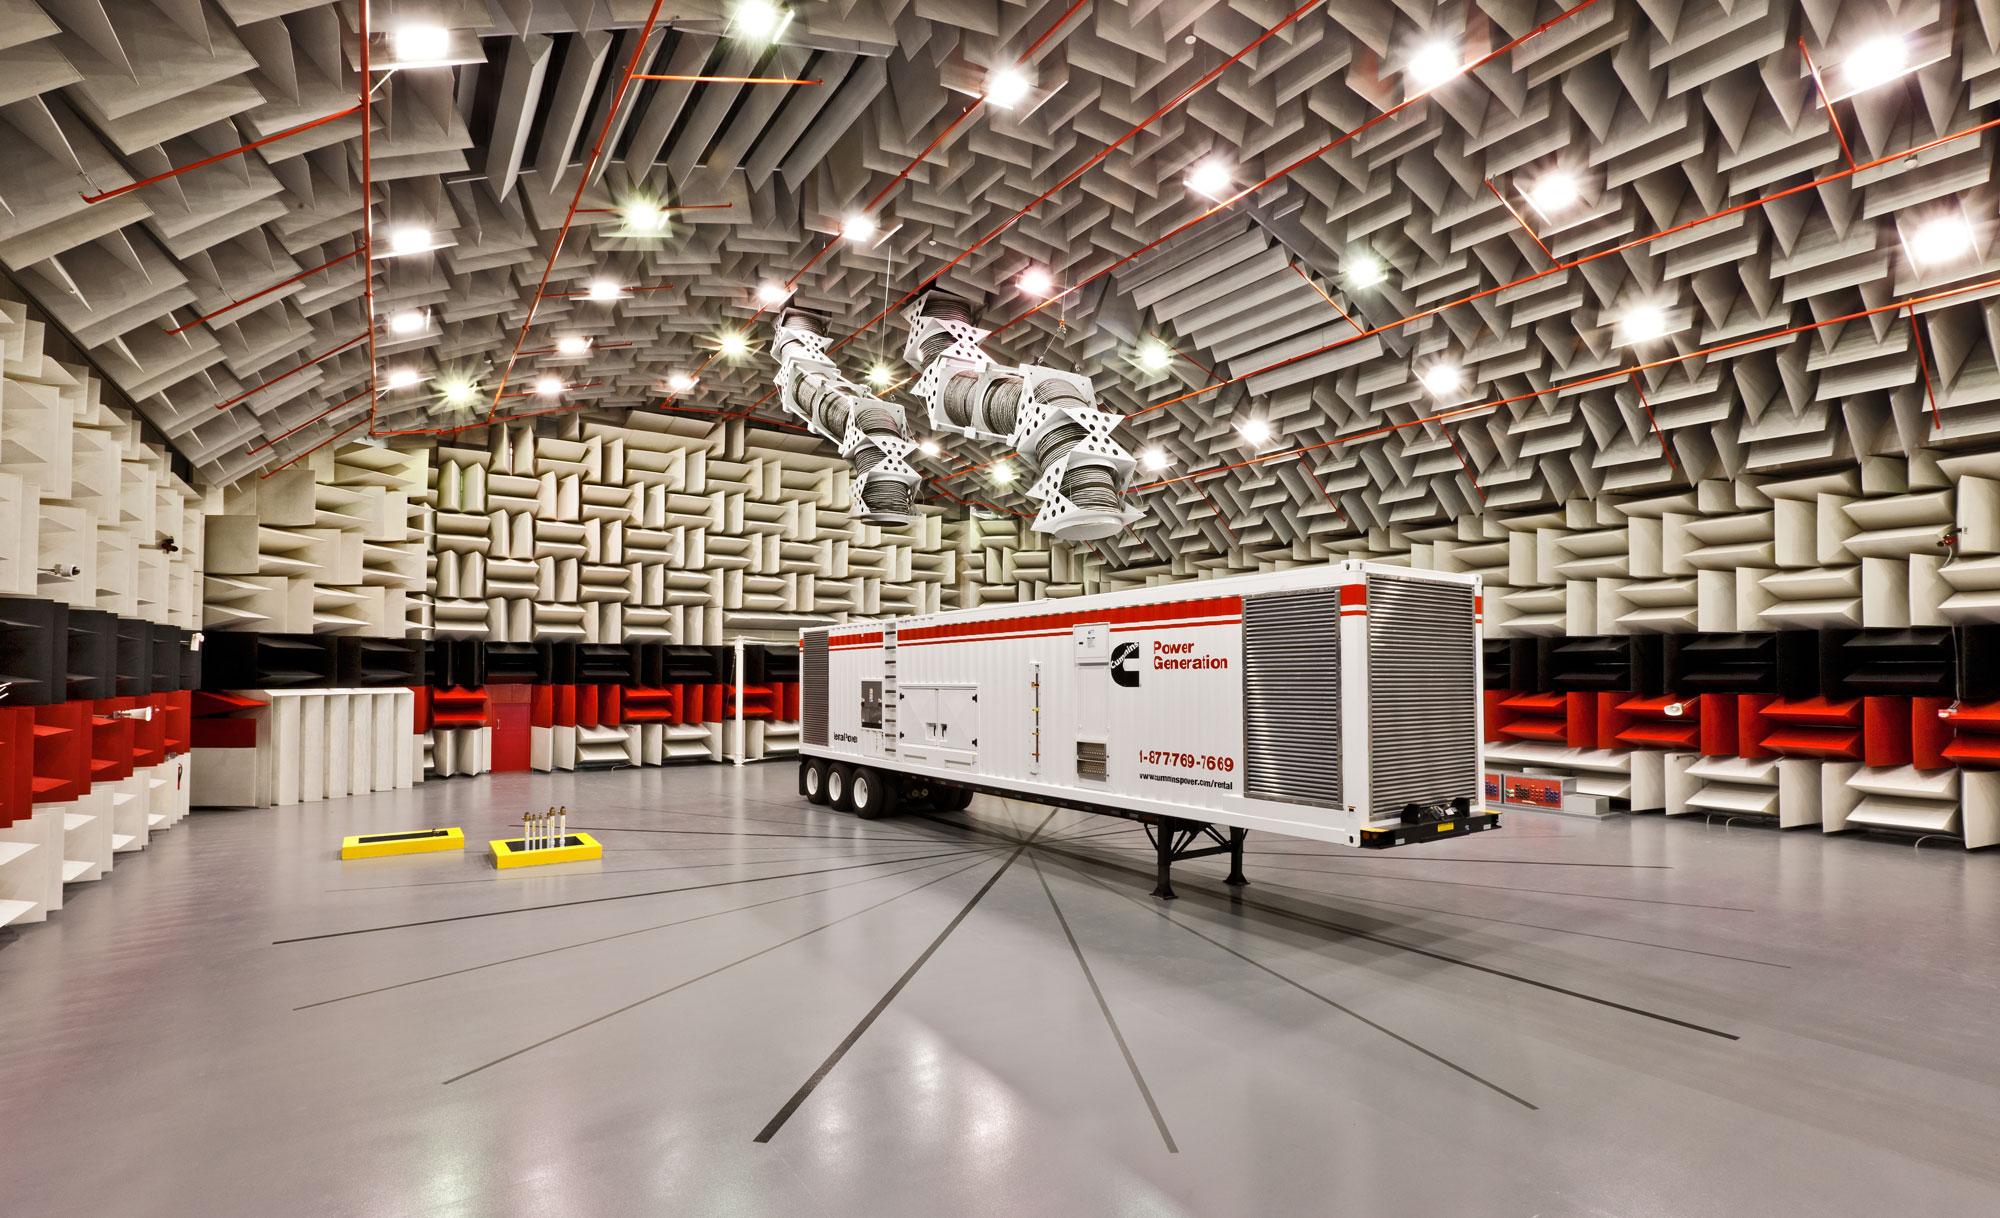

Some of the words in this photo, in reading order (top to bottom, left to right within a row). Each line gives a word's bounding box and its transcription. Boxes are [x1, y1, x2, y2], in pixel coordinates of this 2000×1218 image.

[1153, 641, 1195, 654] Power
[1111, 642, 1139, 669] Cummins
[1153, 655, 1228, 670] Generation
